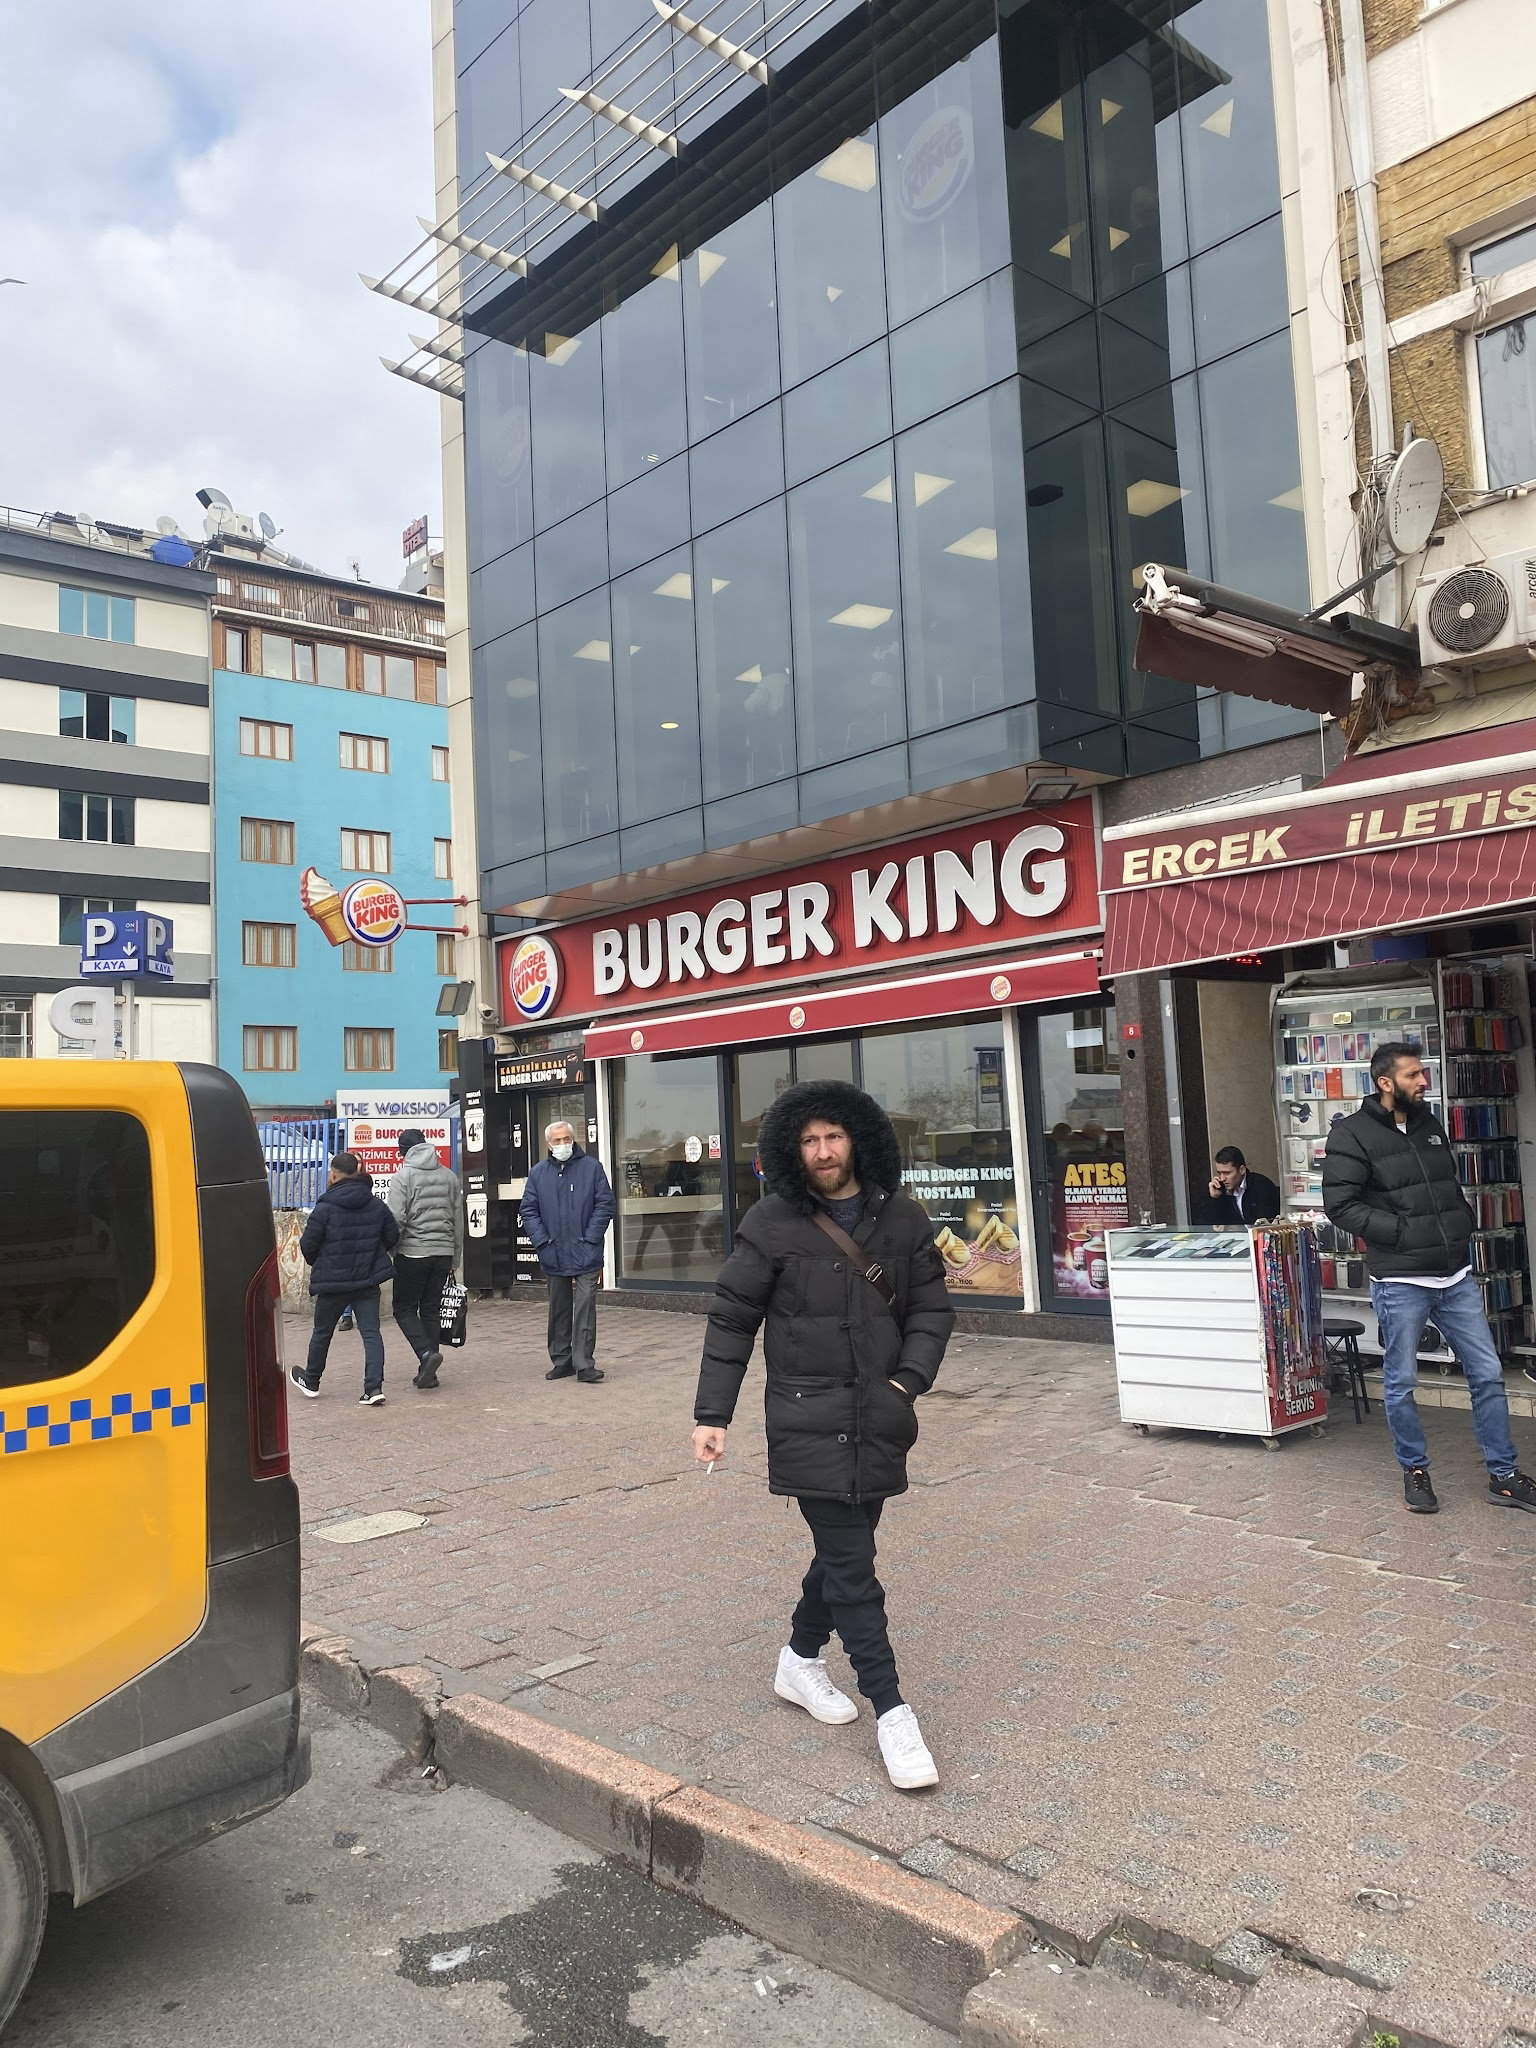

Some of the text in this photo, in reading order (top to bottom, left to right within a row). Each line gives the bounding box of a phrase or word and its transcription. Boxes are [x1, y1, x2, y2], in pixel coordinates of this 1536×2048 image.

[353, 893, 397, 913] BURGER
[592, 824, 1068, 996] BURGER KING
[355, 904, 400, 929] KING
[86, 918, 116, 957] P
[147, 918, 167, 956] P
[94, 961, 126, 971] KAYA
[154, 962, 172, 974] KAYA
[513, 950, 546, 982] BURGER
[514, 963, 548, 1002] KING
[1128, 1026, 1135, 1036] 8
[541, 1060, 567, 1070] KRALI
[500, 1071, 532, 1087] BURGER
[341, 1102, 370, 1117] THE
[375, 1128, 402, 1140] BURG
[365, 1161, 391, 1173] İSTER
[901, 1166, 1013, 1186] ŞHUR BURGER KING
[915, 1186, 976, 1200] TOSTLARI
[1064, 1186, 1127, 1195] OLMAYAN YERDEN
[1064, 1194, 1128, 1206] KAHVE ÇIKMAZ
[1285, 1394, 1315, 1417] SERVİS
